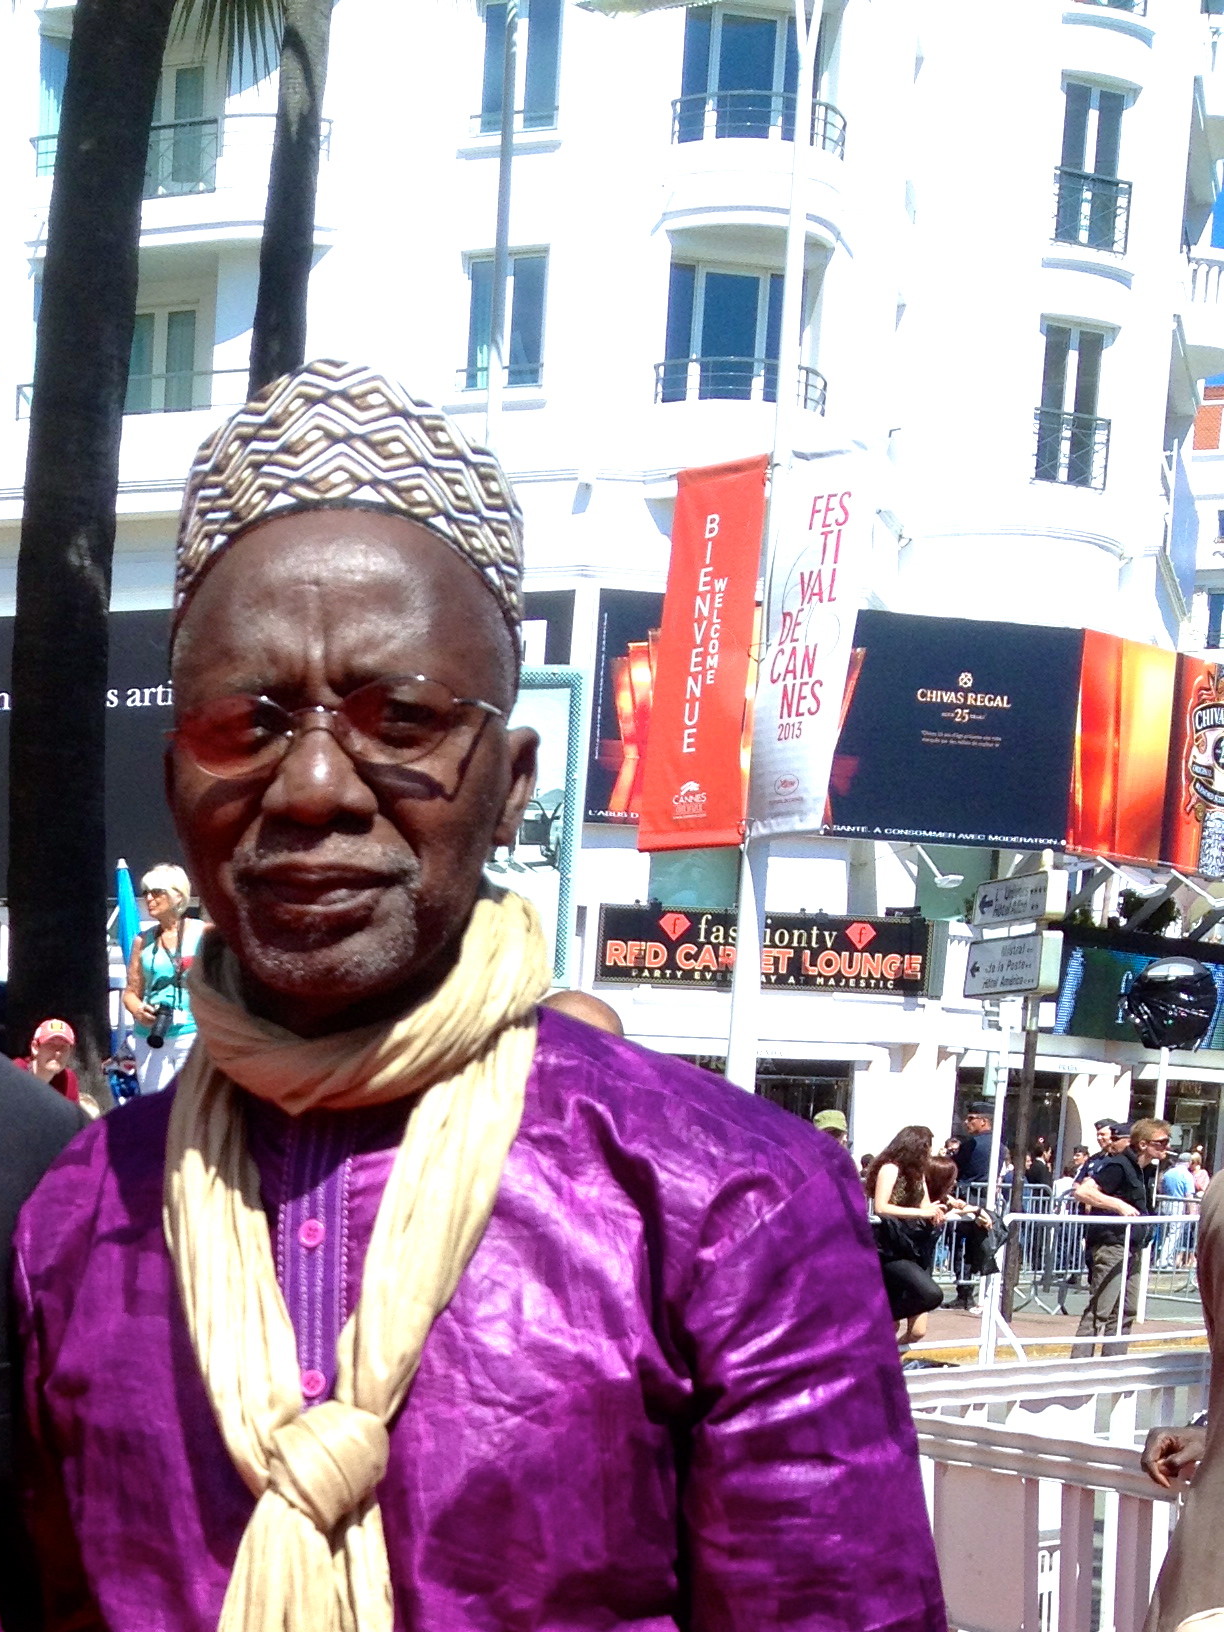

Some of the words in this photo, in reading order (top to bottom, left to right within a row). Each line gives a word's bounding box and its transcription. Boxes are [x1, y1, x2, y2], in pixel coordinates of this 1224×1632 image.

[808, 491, 852, 531] FES
[820, 529, 843, 565] TI
[799, 567, 837, 607] VAL
[682, 514, 720, 753] BIENVENUE
[706, 577, 728, 684] WELCOME
[778, 608, 804, 646] DE
[770, 643, 818, 684] CAN
[779, 679, 824, 720] NES
[917, 688, 965, 705] CHIVAS
[967, 693, 1012, 708] REGAL
[954, 708, 969, 722] 25
[777, 721, 802, 741] 2013
[672, 792, 707, 805] CANNES
[884, 828, 956, 839] CONSOMMER
[606, 940, 668, 968] RED
[676, 943, 794, 976] CARET
[801, 950, 923, 980] LOUNGE
[632, 969, 684, 980] PARTY
[788, 976, 805, 984] AT
[817, 976, 895, 989] MAJESTIC
